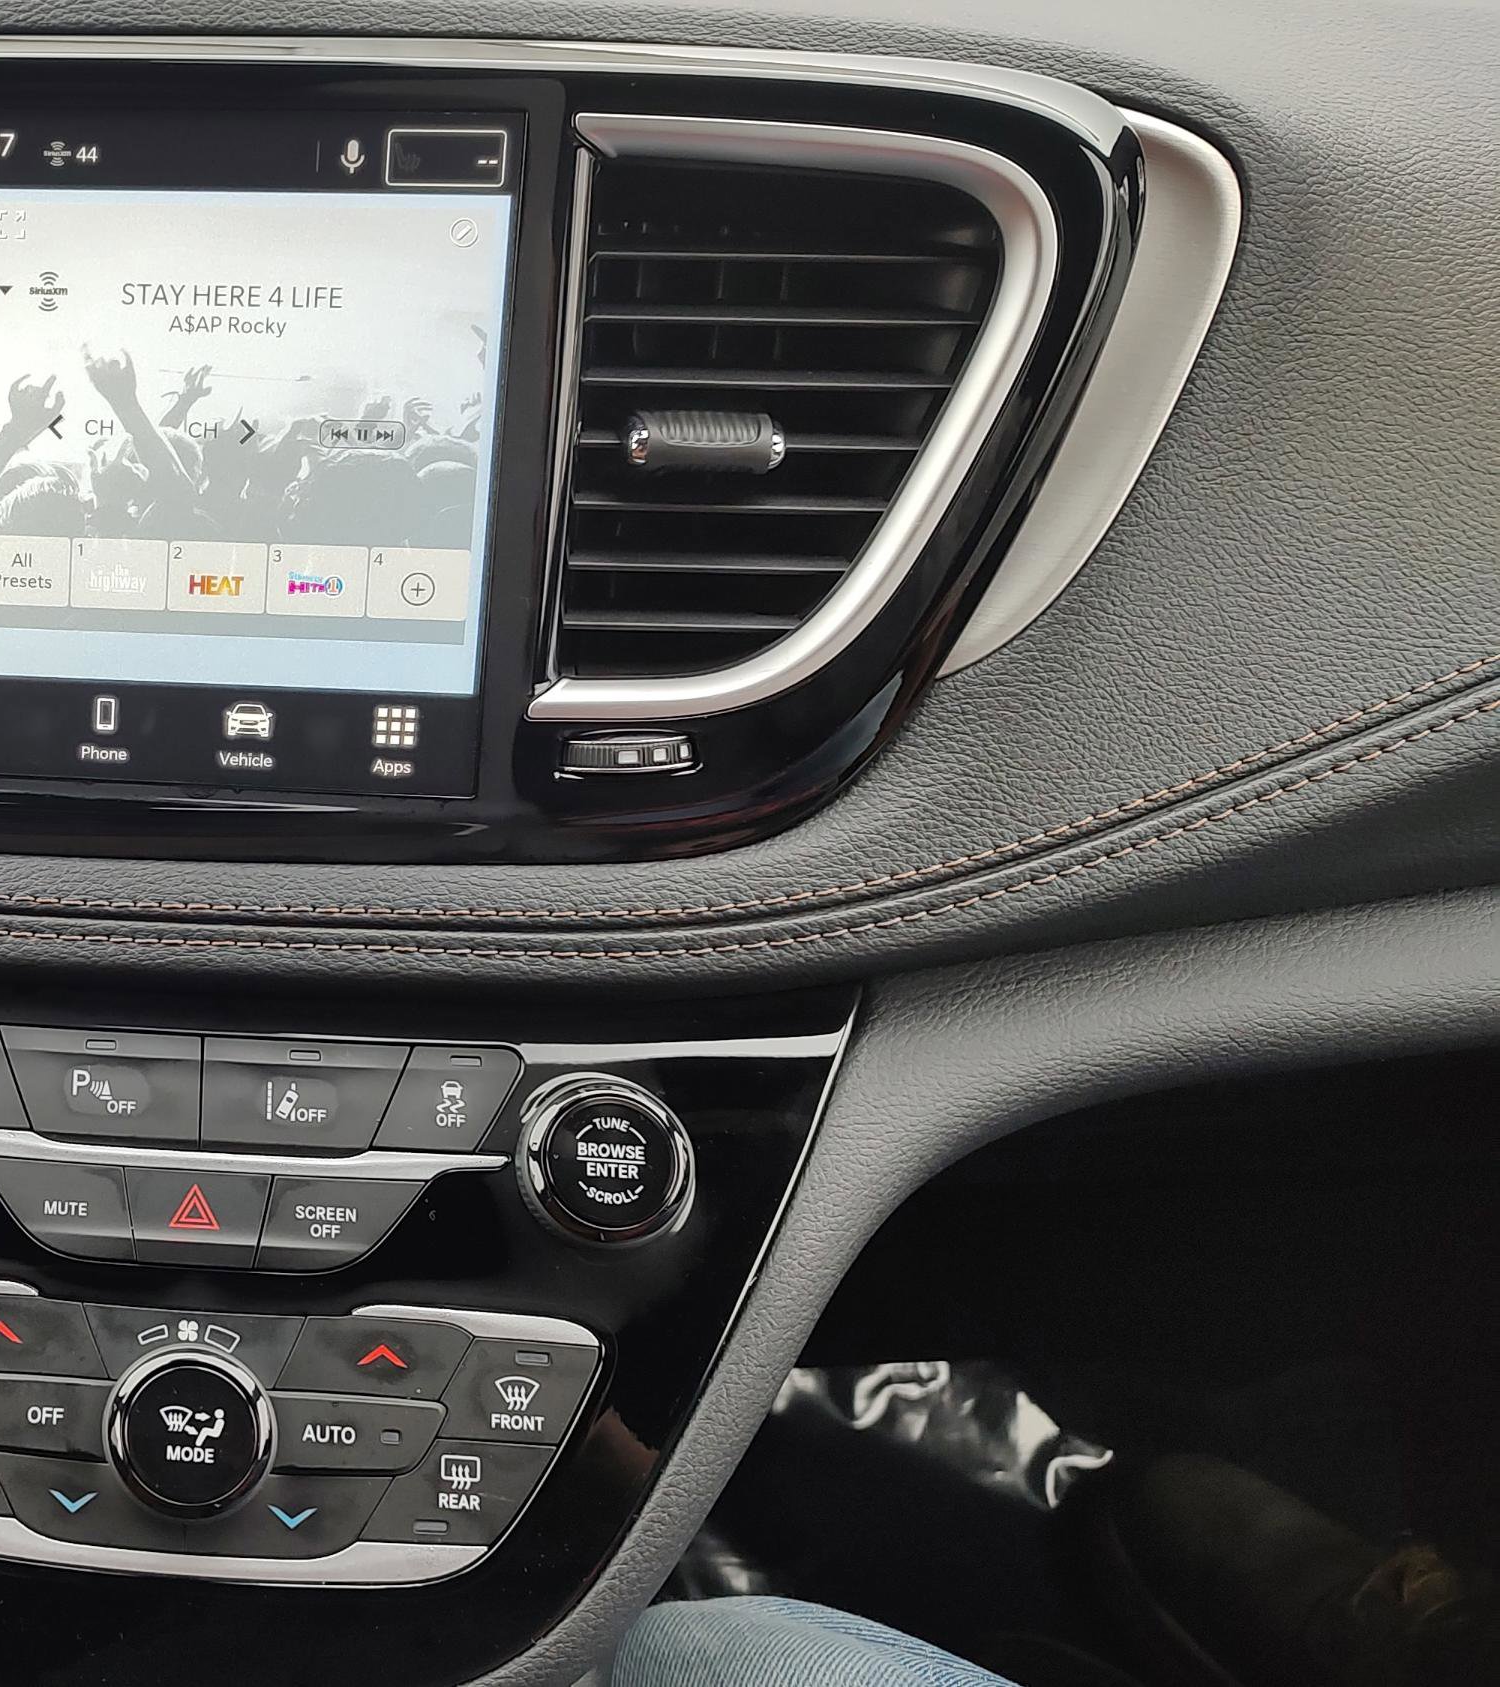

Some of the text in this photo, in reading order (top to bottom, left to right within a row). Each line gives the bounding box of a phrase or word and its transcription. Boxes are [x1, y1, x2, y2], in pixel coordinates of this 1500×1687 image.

[75, 146, 99, 162] 44
[121, 283, 344, 309] STAY HERE 4 LIFE
[168, 314, 287, 338] A$AP Rocky
[85, 420, 114, 436] CH
[188, 422, 219, 439] CH
[77, 543, 83, 557] 1
[173, 546, 183, 560] 2
[272, 550, 283, 564] 3
[11, 553, 33, 568] All
[373, 553, 384, 567] 4
[188, 574, 245, 596] HEAT
[80, 745, 127, 762] Phone
[218, 751, 273, 768] Vehicle
[372, 759, 411, 776] Apps
[106, 1101, 137, 1114] OFF
[297, 1109, 327, 1123] OFF
[436, 1114, 466, 1128] OFF
[592, 1117, 630, 1133] TUNE
[577, 1142, 646, 1161] BROWSE
[586, 1162, 639, 1180] ENTER
[586, 1186, 639, 1205] SCROLL
[44, 1201, 88, 1216] MUTE
[295, 1206, 357, 1223] SCREEN
[310, 1223, 341, 1239] OFF
[27, 1407, 65, 1424] OFF
[490, 1414, 545, 1432] FRONT
[302, 1425, 357, 1445] AUTO
[166, 1445, 215, 1464] MODE
[438, 1493, 481, 1511] REAR
